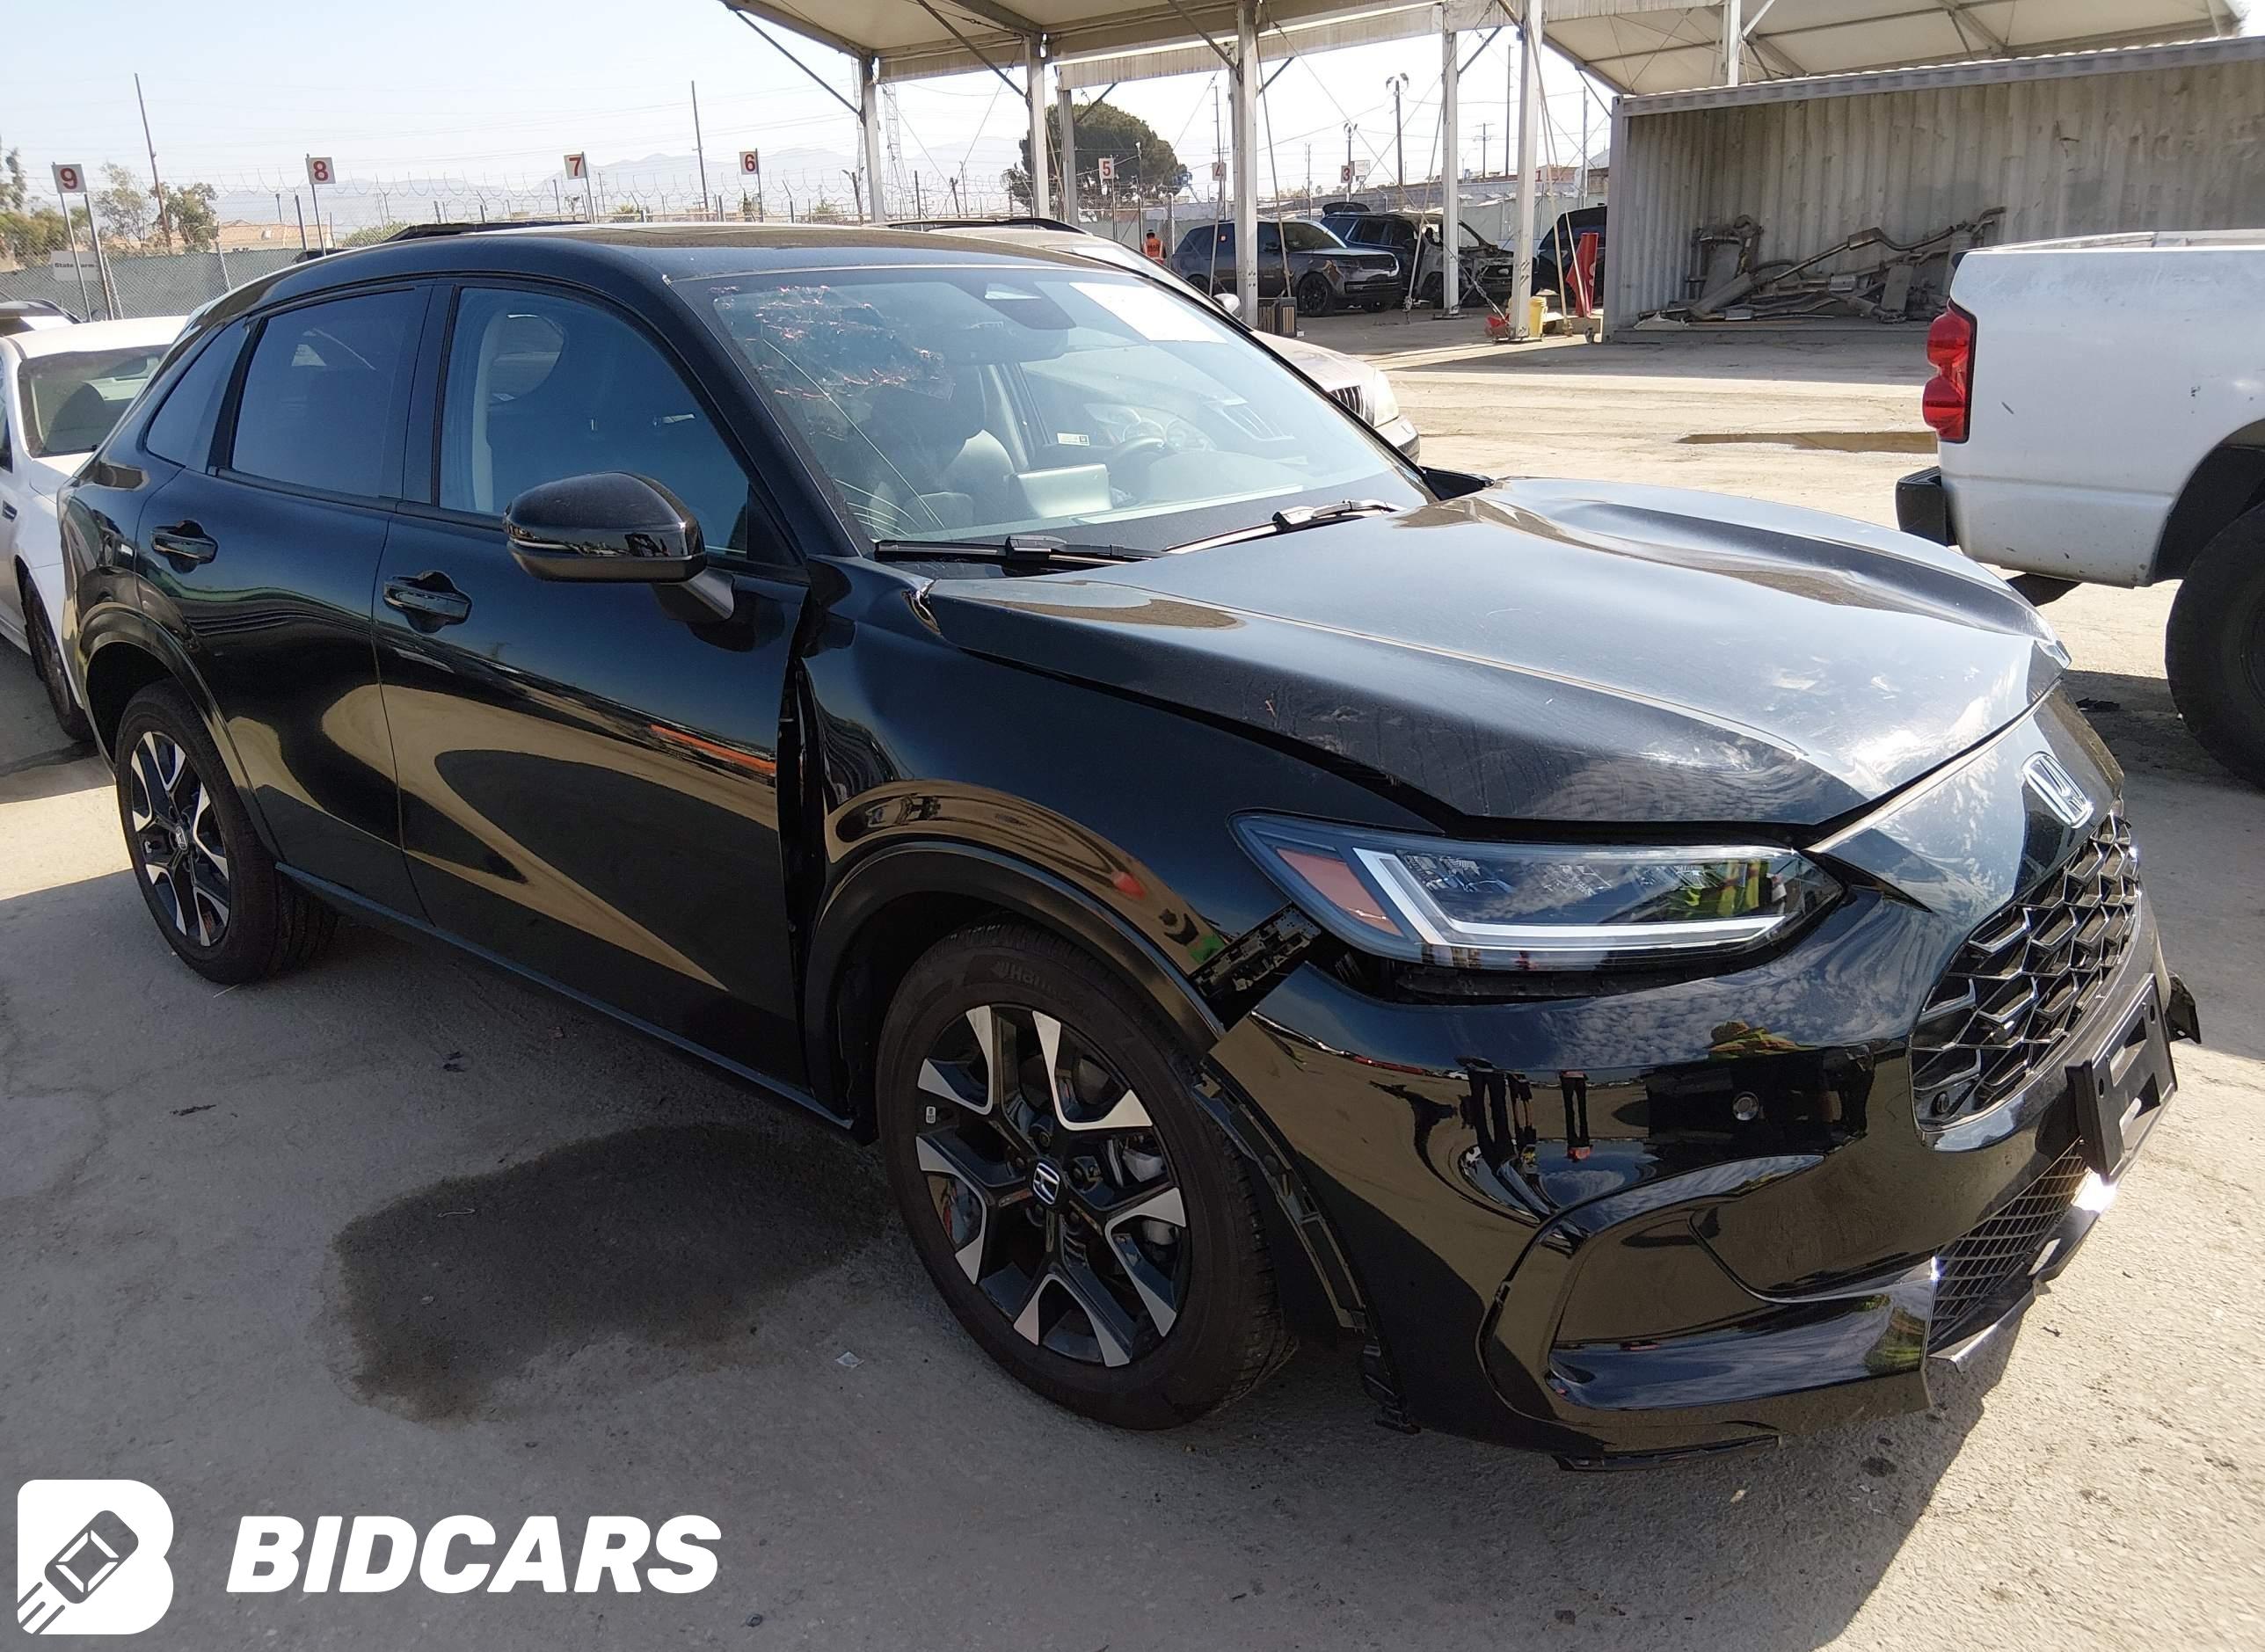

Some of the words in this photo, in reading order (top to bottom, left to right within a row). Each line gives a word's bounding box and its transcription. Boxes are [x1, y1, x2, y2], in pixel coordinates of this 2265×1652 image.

[313, 160, 329, 182] 8
[569, 156, 581, 177] 7
[745, 153, 756, 172] 6
[1102, 160, 1111, 177] 5
[60, 167, 78, 190] 9
[1343, 167, 1351, 182] 3
